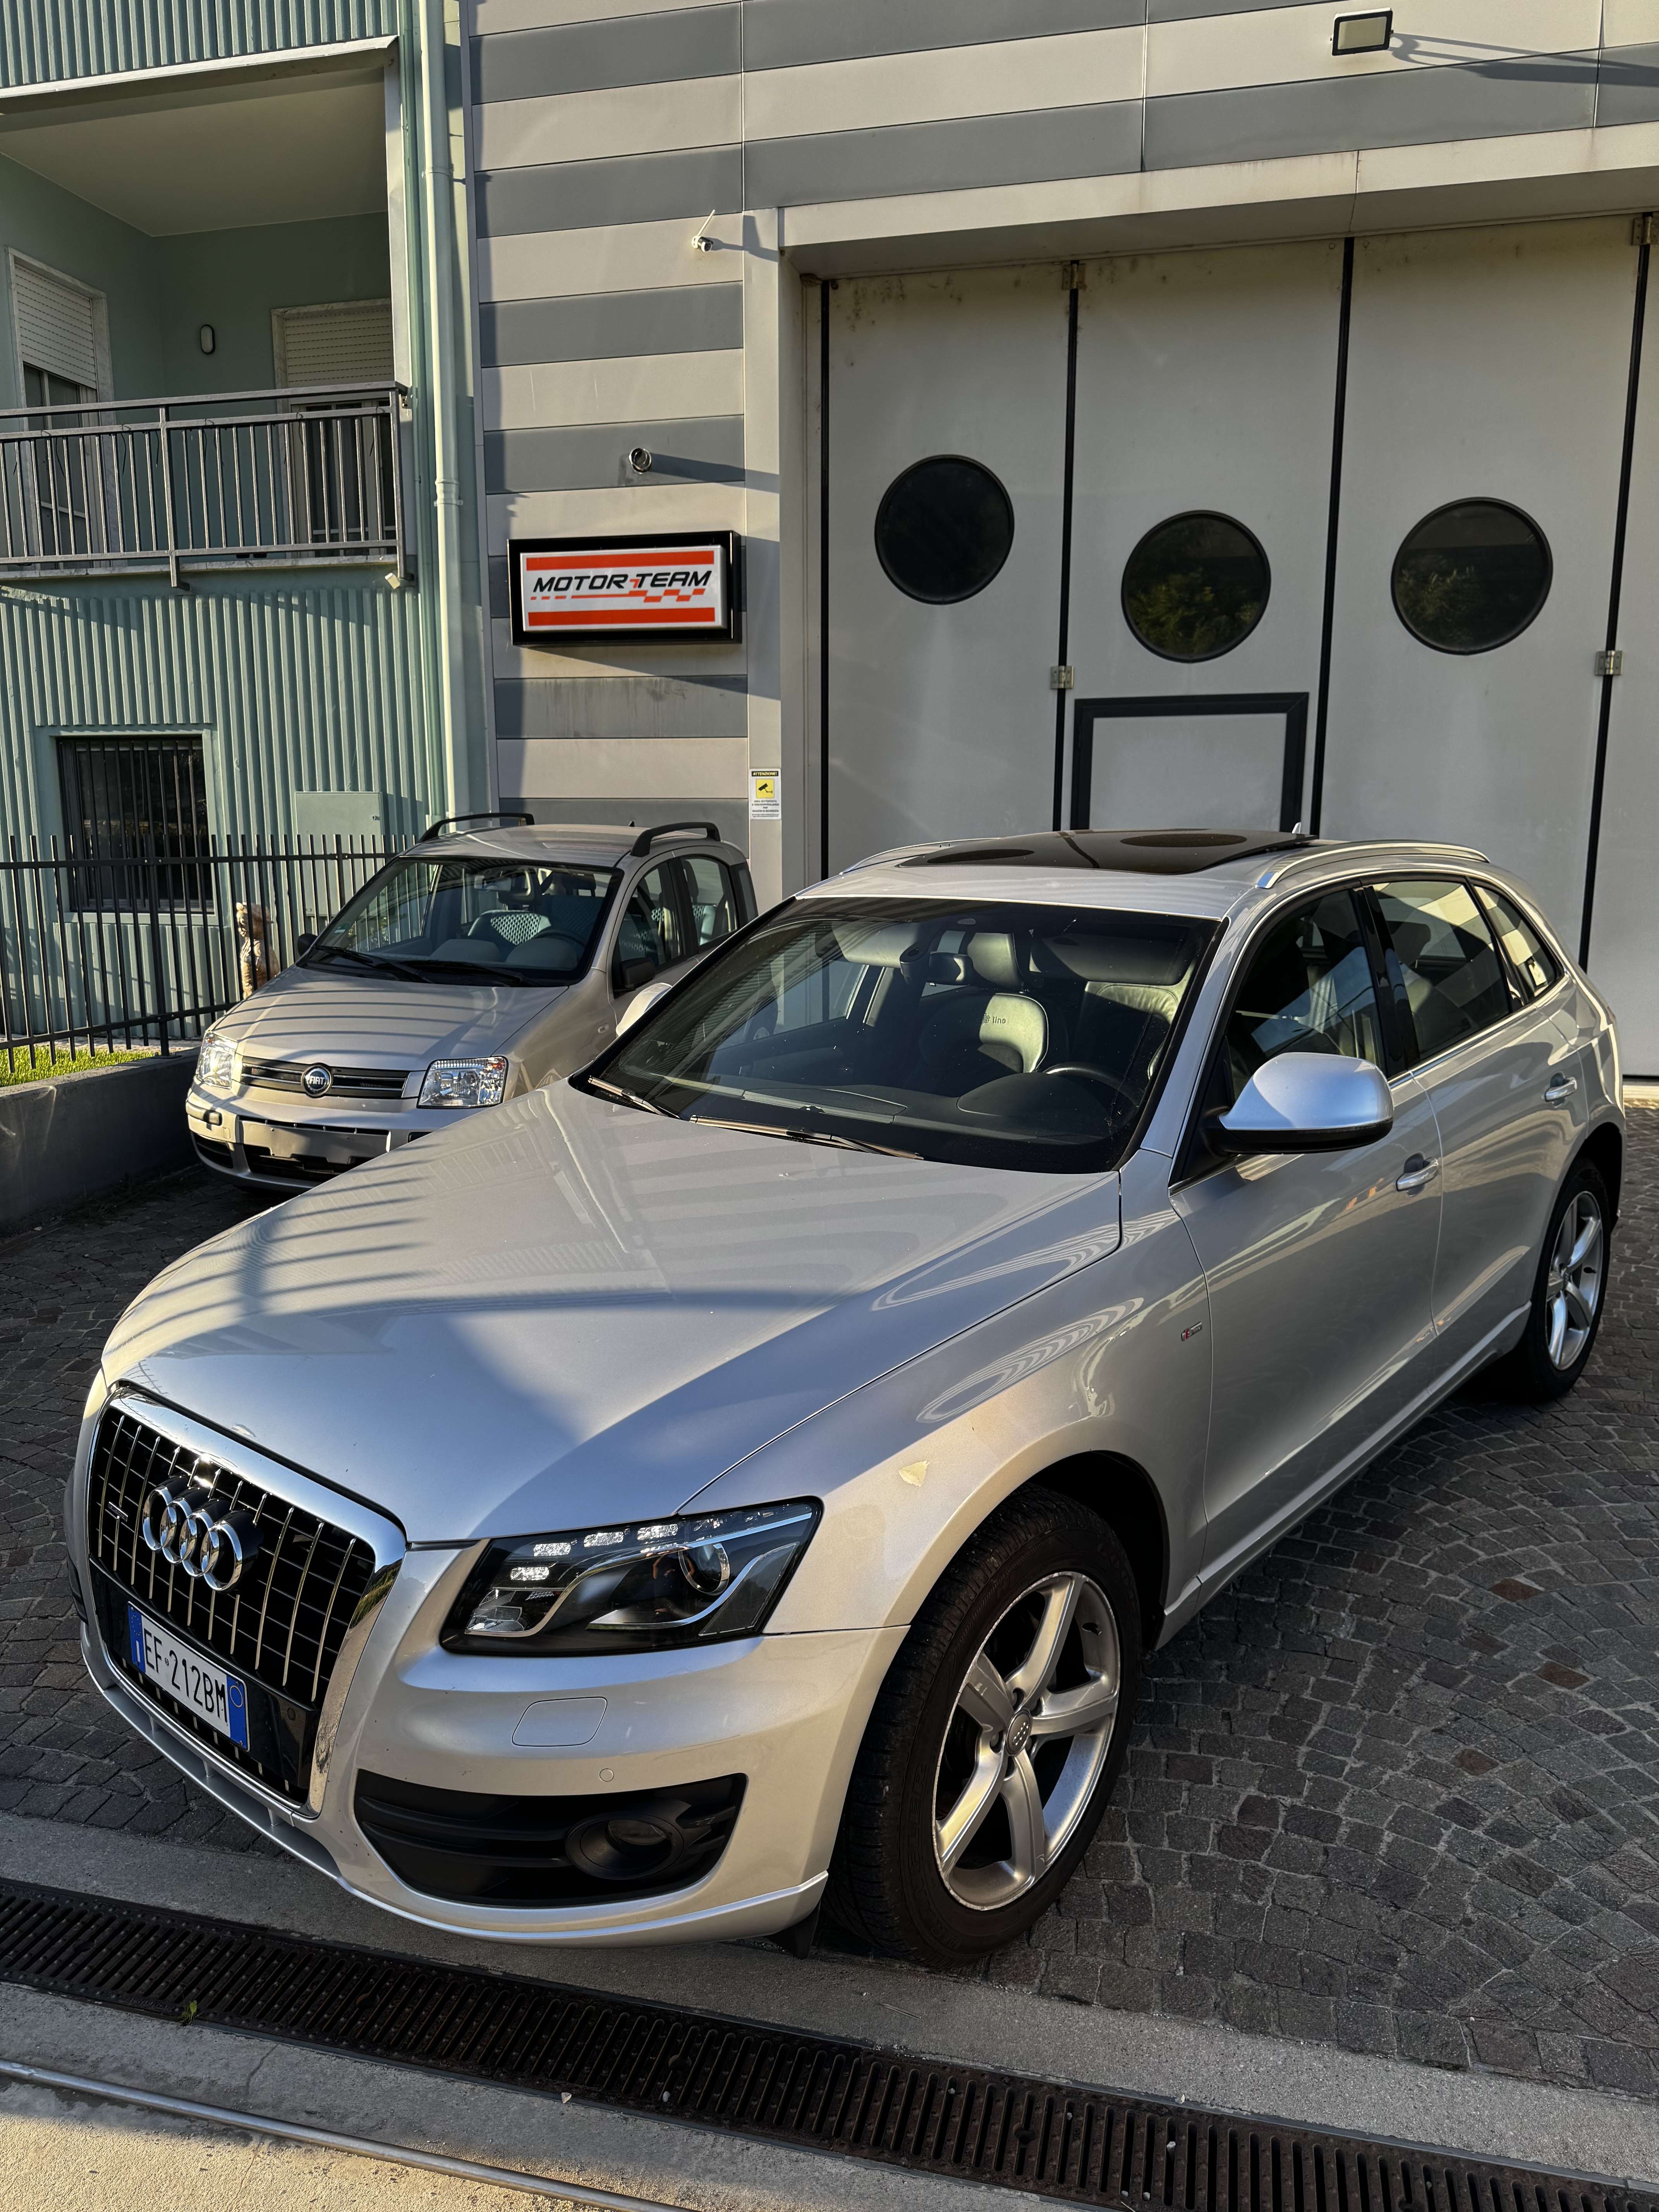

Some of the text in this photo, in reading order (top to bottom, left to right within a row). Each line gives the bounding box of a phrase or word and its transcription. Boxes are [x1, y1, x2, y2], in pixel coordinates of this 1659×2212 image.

[533, 570, 711, 592] MOTOR TEAM
[309, 1076, 325, 1084] FIAT
